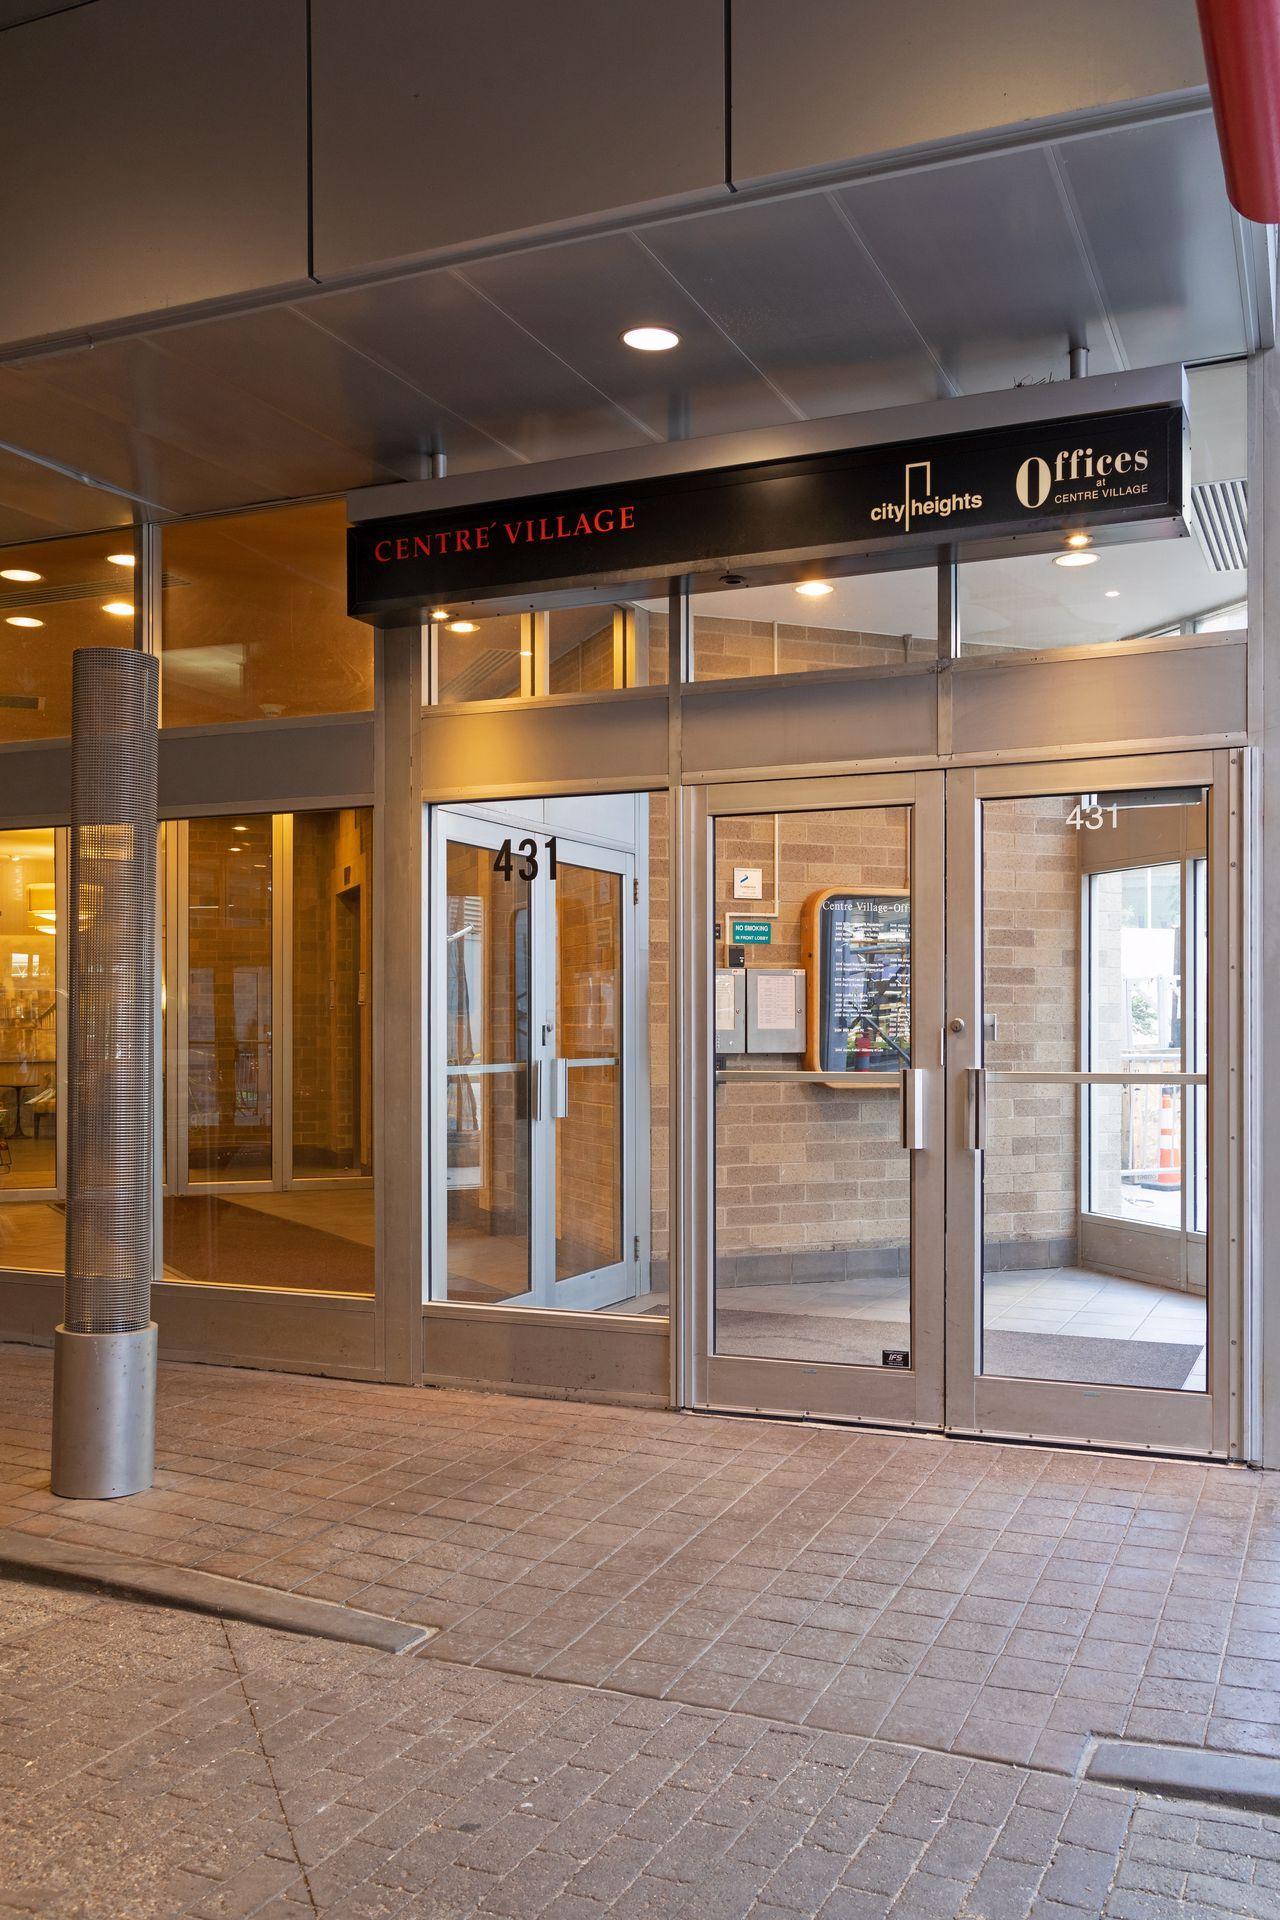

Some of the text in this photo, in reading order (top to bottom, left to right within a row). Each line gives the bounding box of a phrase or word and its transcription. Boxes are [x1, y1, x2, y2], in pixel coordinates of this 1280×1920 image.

[1015, 447, 1149, 509] Offices
[1095, 478, 1107, 488] at
[870, 492, 983, 522] city heights
[1054, 483, 1149, 504] CENTRE VILLAGE
[504, 506, 635, 544] VILLAGE
[1065, 803, 1118, 830] 431
[493, 836, 557, 882] 431
[822, 900, 853, 911] Centre
